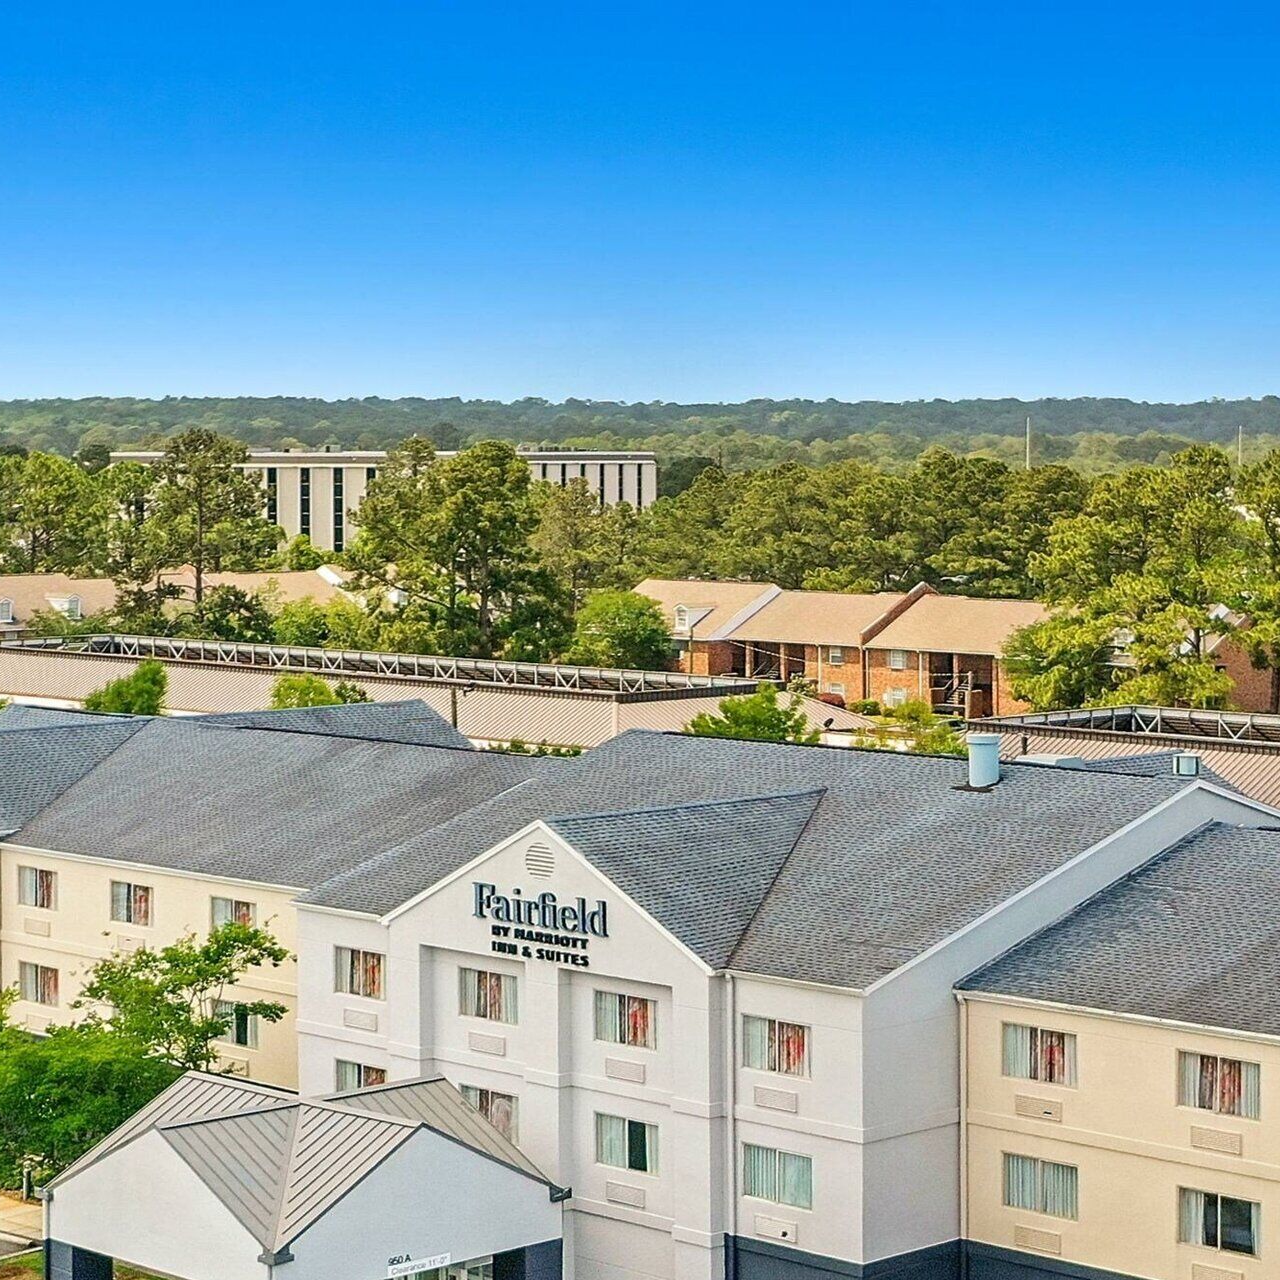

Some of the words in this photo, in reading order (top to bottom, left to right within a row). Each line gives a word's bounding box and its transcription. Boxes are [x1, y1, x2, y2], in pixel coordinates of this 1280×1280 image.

[472, 882, 609, 938] Fairfield
[491, 925, 511, 937] BY
[514, 928, 589, 950] MARRIOTT
[491, 941, 518, 956] INN
[521, 946, 532, 959] &
[536, 948, 589, 968] SUITES
